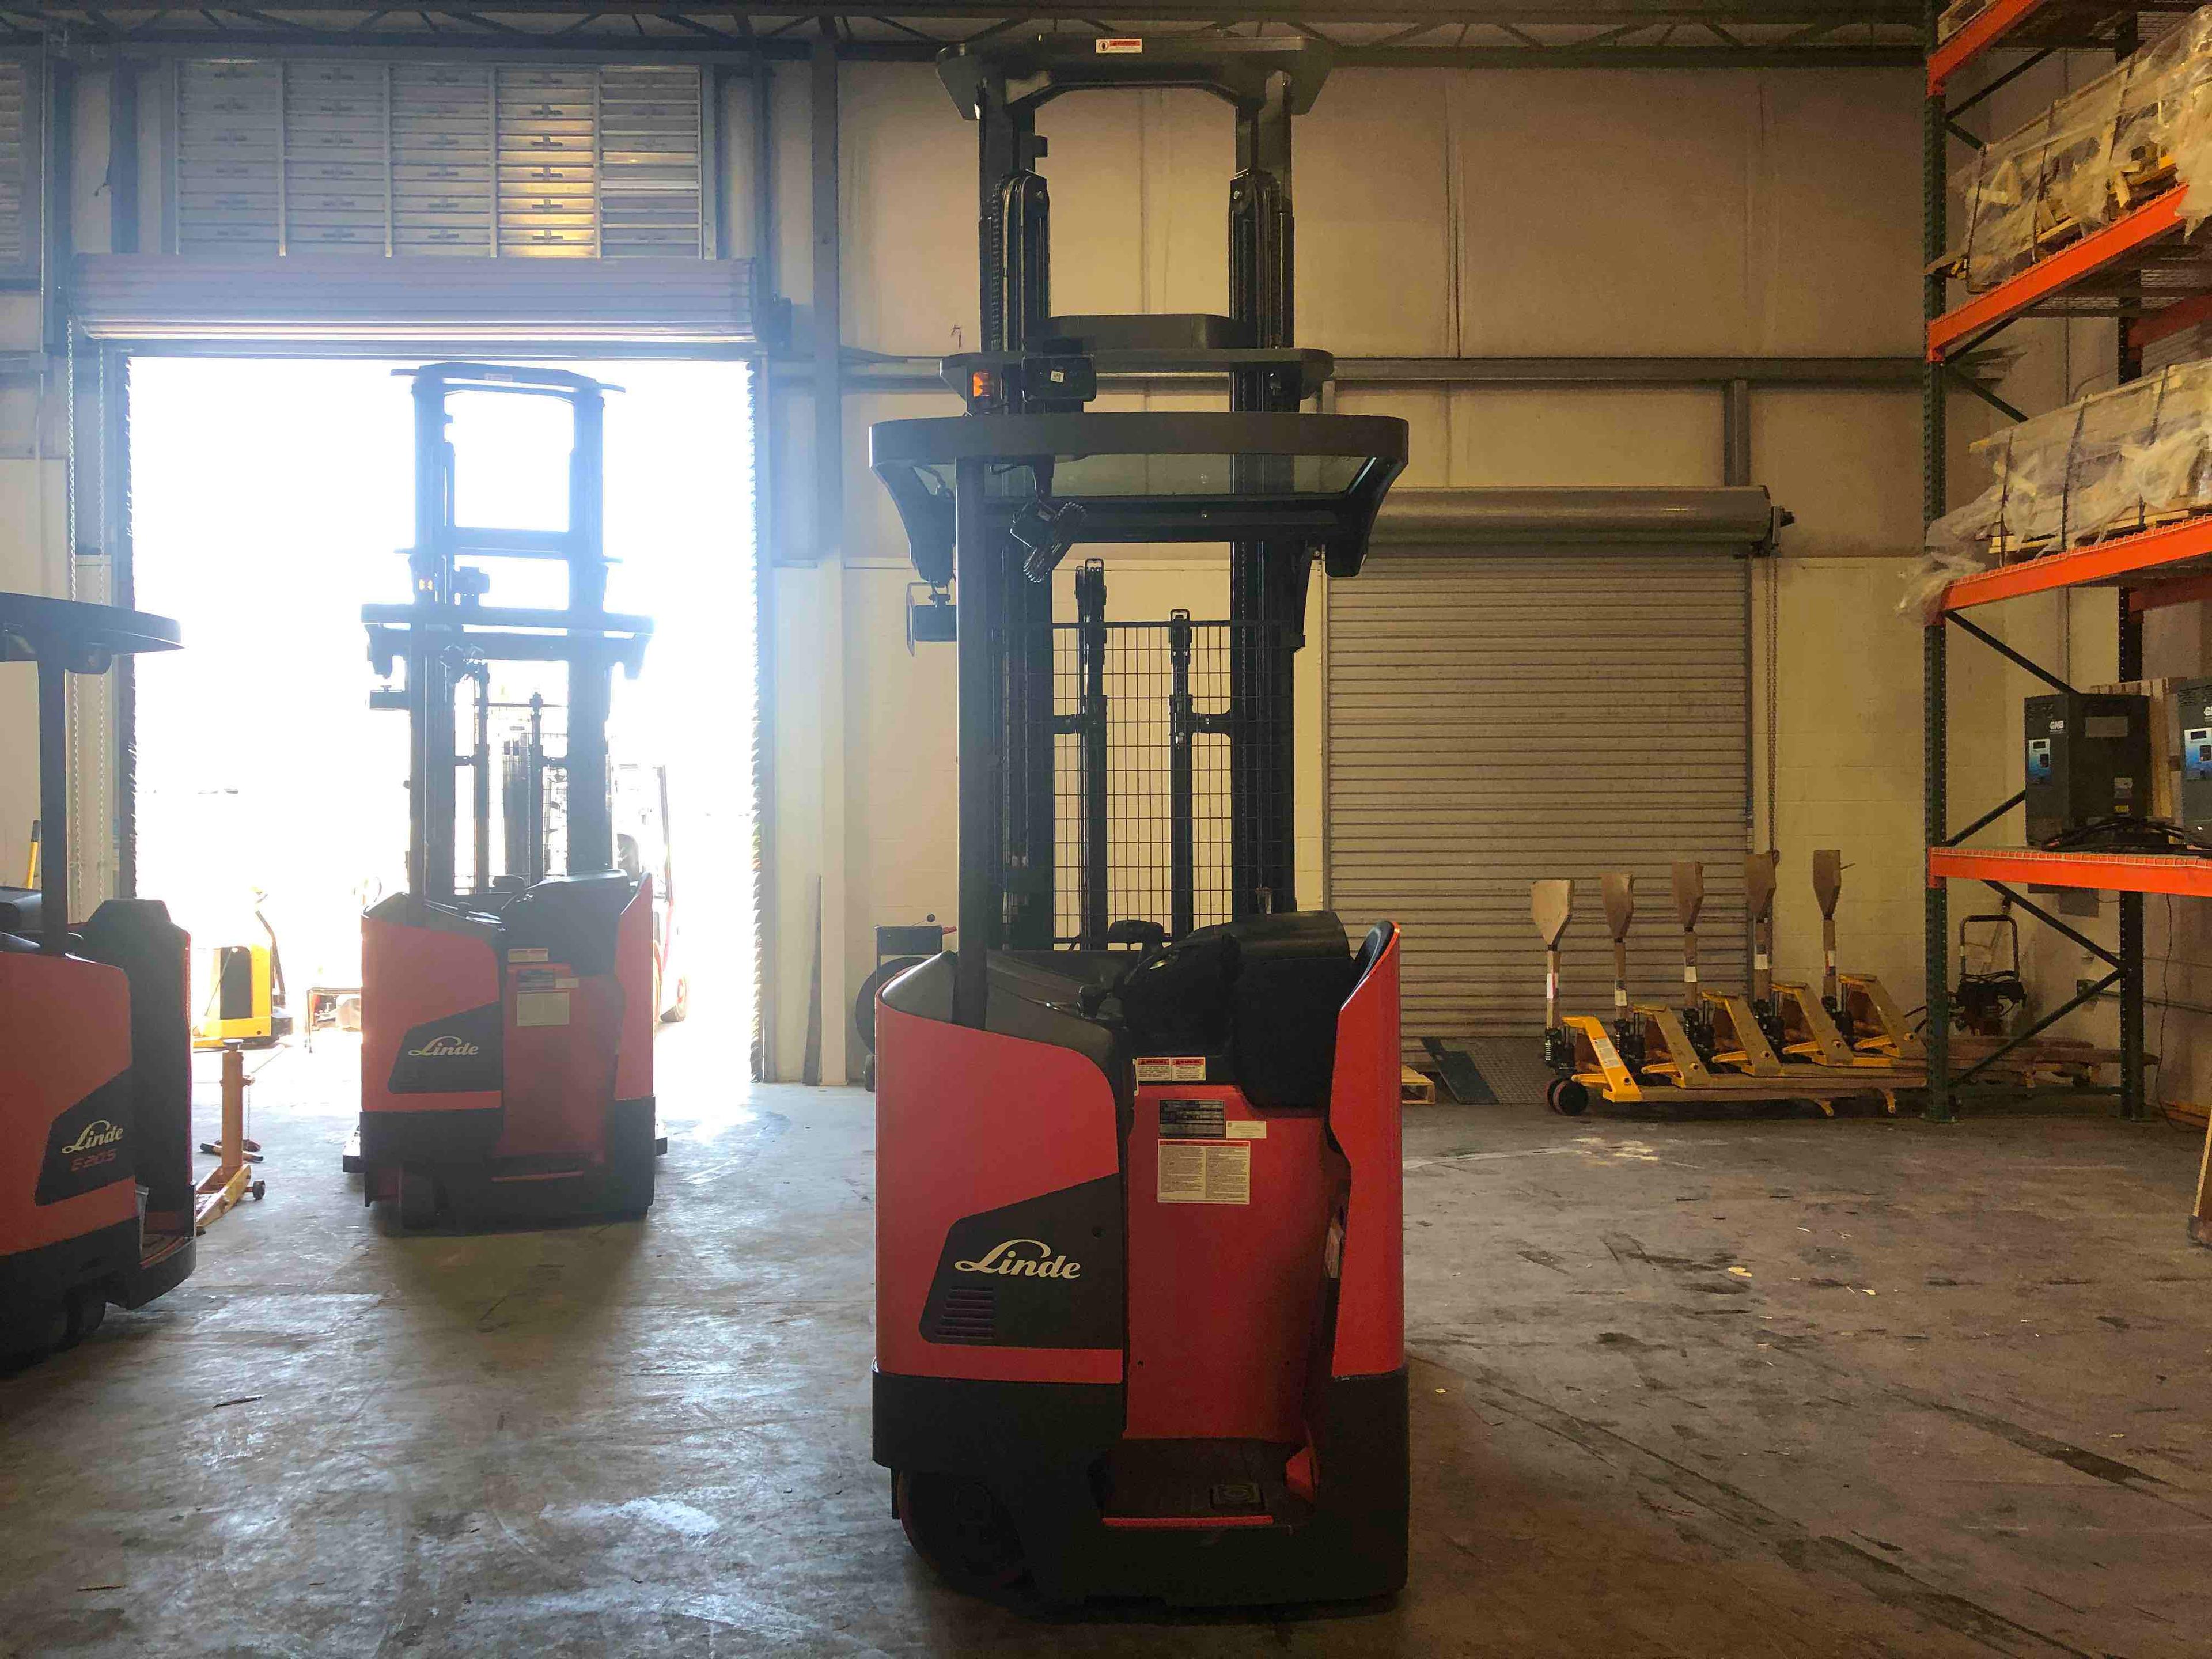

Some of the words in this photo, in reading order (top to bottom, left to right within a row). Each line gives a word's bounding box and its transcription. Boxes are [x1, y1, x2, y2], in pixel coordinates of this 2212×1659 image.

[408, 1036, 479, 1056] Linde
[62, 1120, 123, 1153] Linde
[955, 1238, 1081, 1279] Linde
